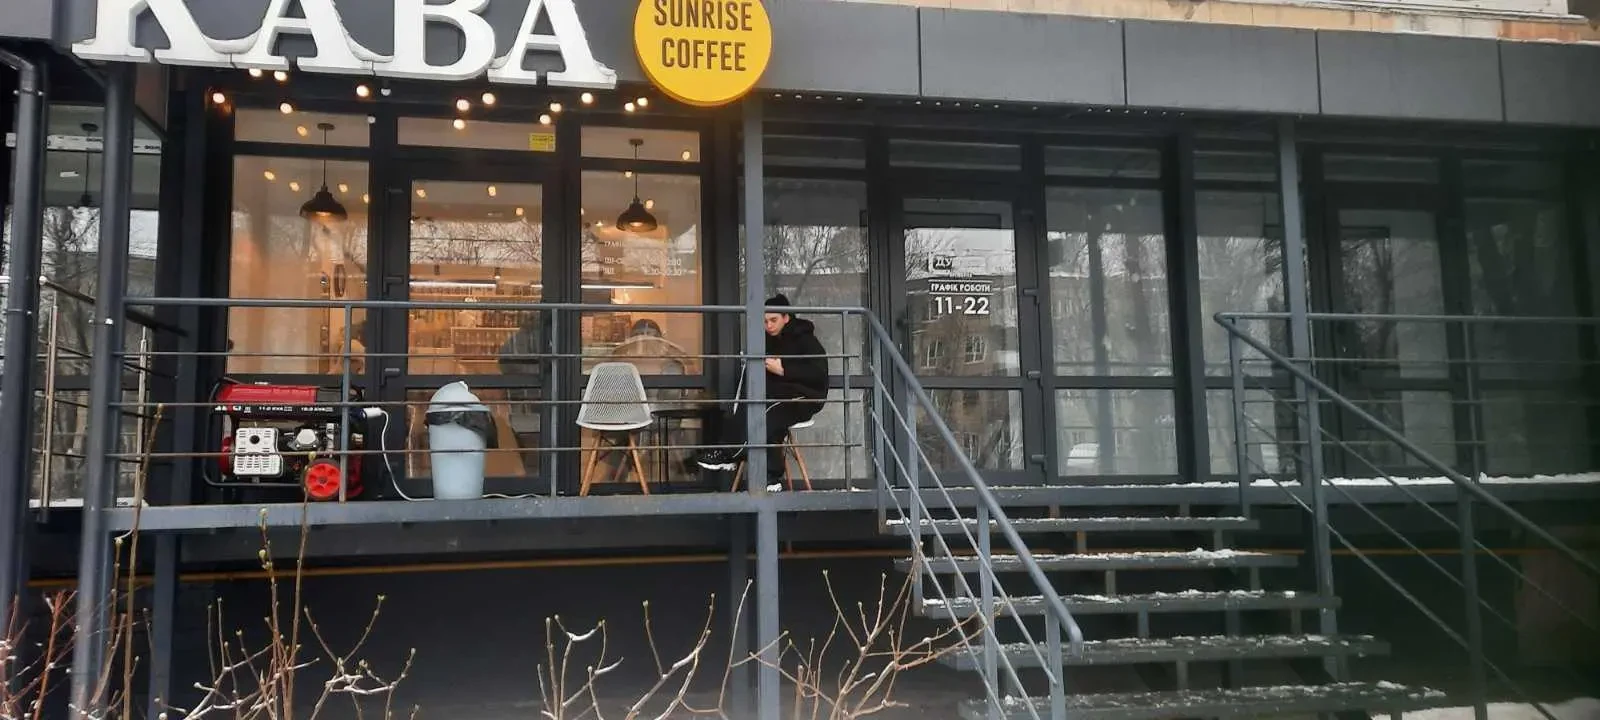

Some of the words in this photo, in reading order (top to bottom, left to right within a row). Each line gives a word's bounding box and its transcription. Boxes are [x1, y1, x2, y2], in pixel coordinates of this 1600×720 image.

[654, 0, 753, 31] SUNRISE
[661, 37, 747, 72] COFFEE
[930, 283, 958, 292] ГРАФІК
[960, 284, 991, 293] РОБОТИ
[934, 296, 990, 315] 11-22
